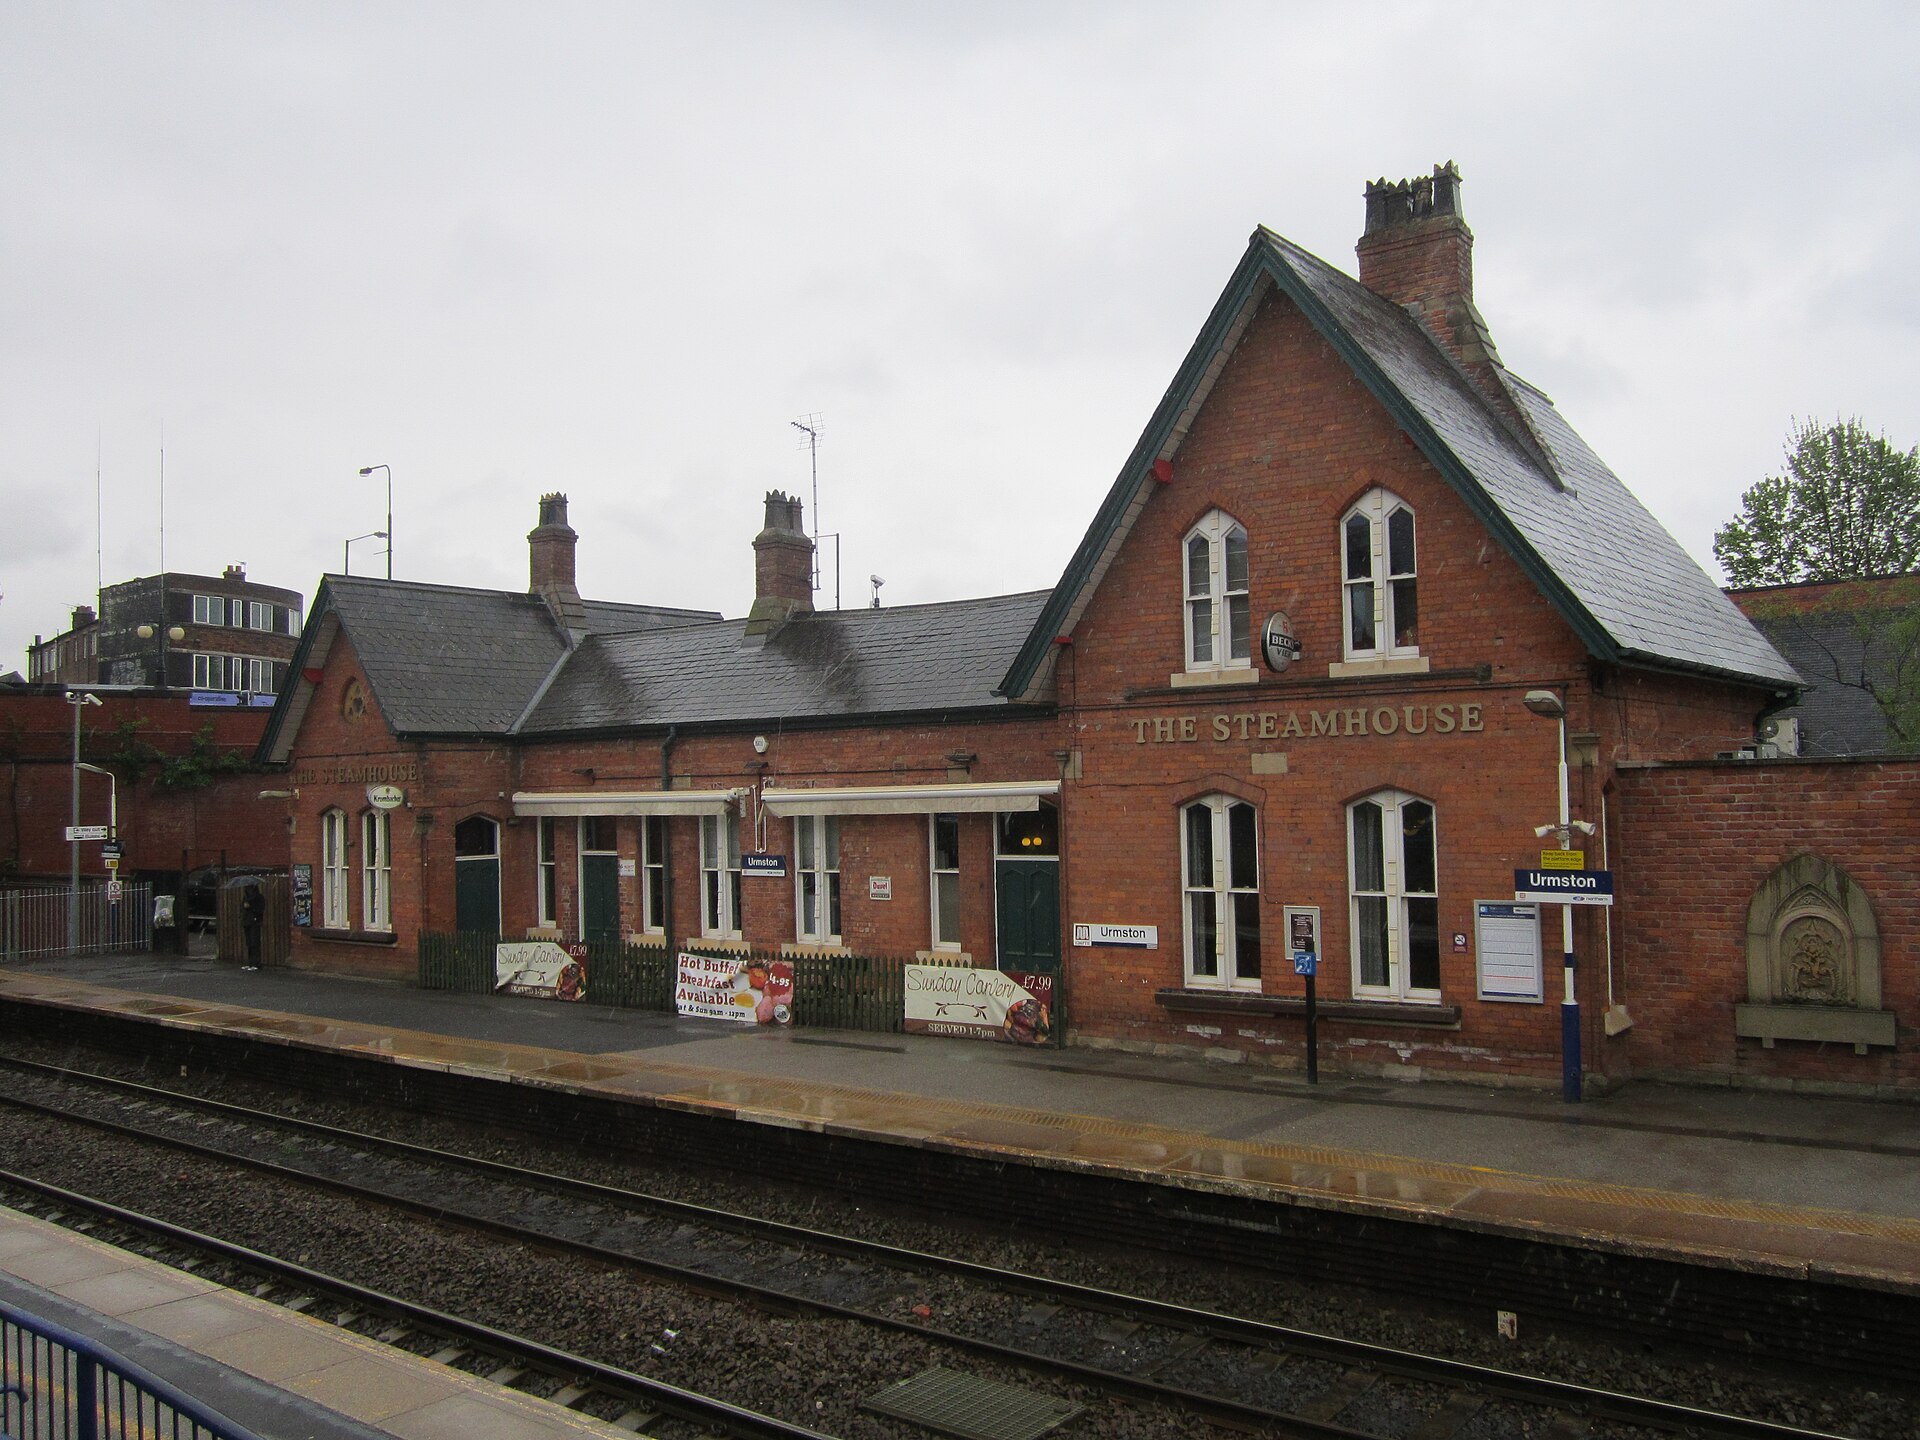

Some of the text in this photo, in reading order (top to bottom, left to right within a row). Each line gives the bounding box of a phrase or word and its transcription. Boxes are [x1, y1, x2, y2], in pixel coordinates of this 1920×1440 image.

[1130, 703, 1485, 744] THE STEAMHOUSE
[292, 763, 417, 785] THE STEAMHOUSE
[747, 857, 778, 867] Urmston
[1530, 872, 1597, 888] Urmston
[1100, 926, 1146, 939] Urmston
[498, 946, 530, 964] Sunda
[570, 944, 588, 957] £7.99
[680, 955, 739, 974] Hot Buffet
[679, 972, 735, 989] Breakfast
[907, 968, 1016, 1005] Sunday Carvery
[1023, 974, 1052, 990] £7.99
[676, 988, 736, 1006] Available
[688, 1004, 695, 1012] &
[696, 1005, 708, 1014] Sun
[709, 1008, 724, 1016] 9am
[729, 1010, 746, 1019] 12pm
[927, 1023, 996, 1038] SERVED 1-7pm
